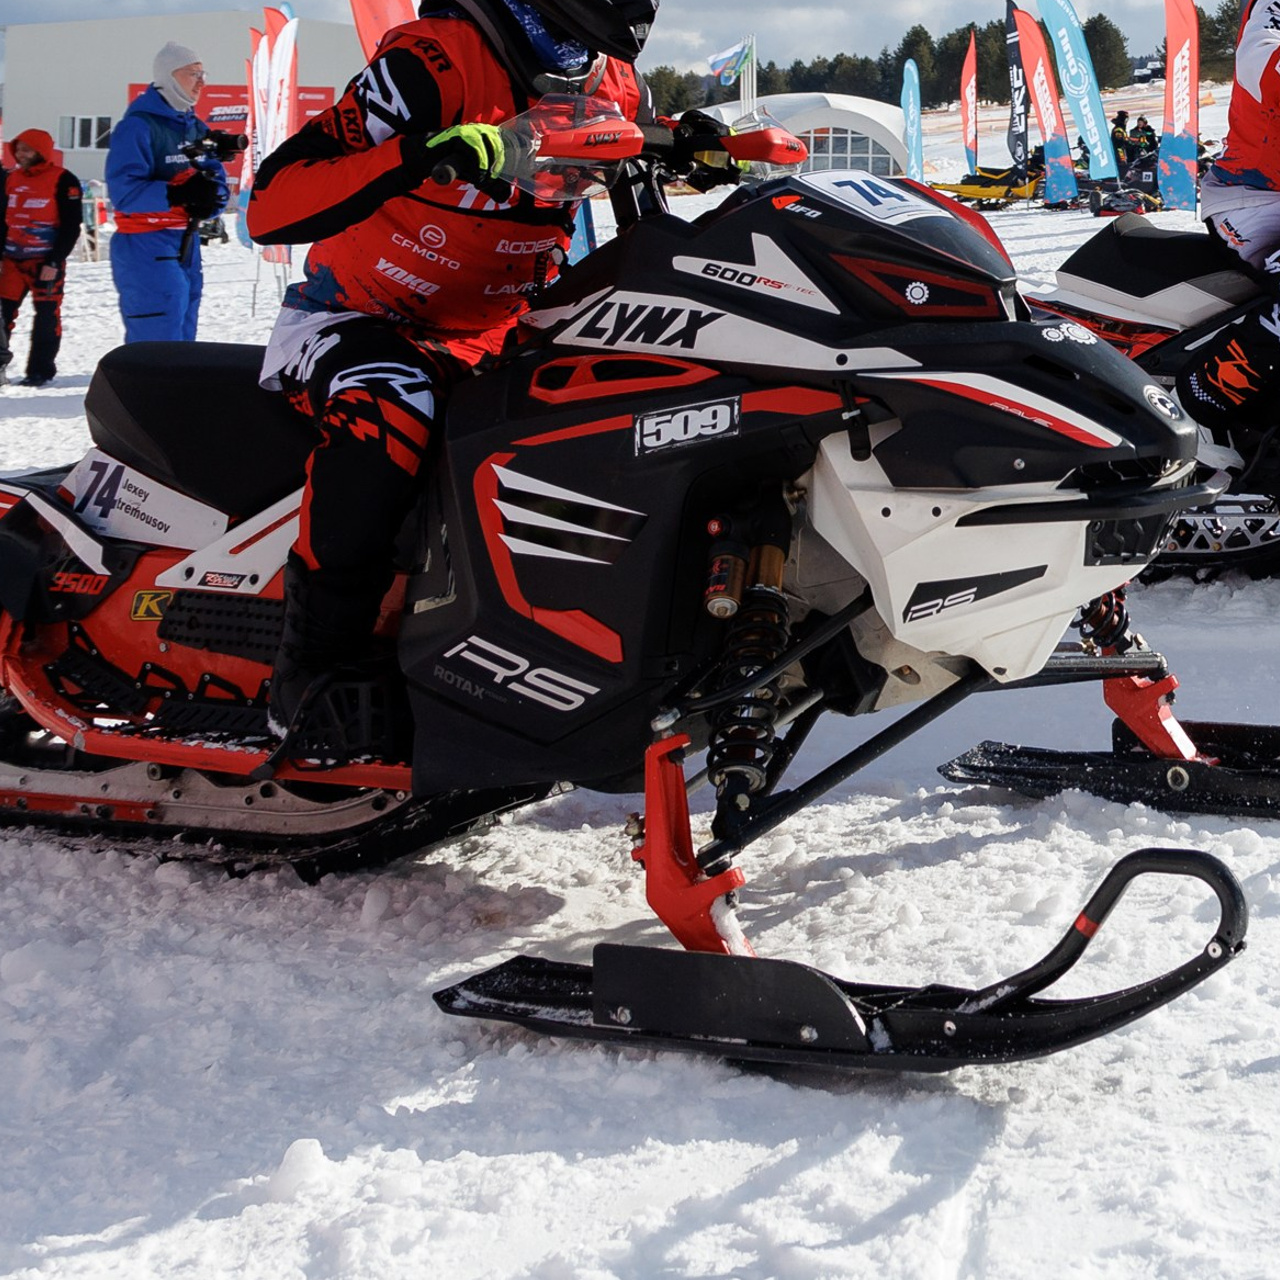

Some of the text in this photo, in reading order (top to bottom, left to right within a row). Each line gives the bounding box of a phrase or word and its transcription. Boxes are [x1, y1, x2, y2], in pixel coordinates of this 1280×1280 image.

[582, 132, 623, 147] LYNX
[785, 203, 823, 219] UFO
[832, 179, 909, 207] 74
[391, 232, 461, 270] CFMOTO
[373, 257, 441, 296] YOKO
[576, 301, 728, 350] LYNX
[642, 403, 732, 448] 509
[75, 460, 126, 519] 74
[122, 478, 150, 503] lexey
[116, 497, 171, 534] tremousov
[907, 586, 978, 624] RS
[433, 664, 485, 700] ROTAX
[443, 634, 601, 712] RS
